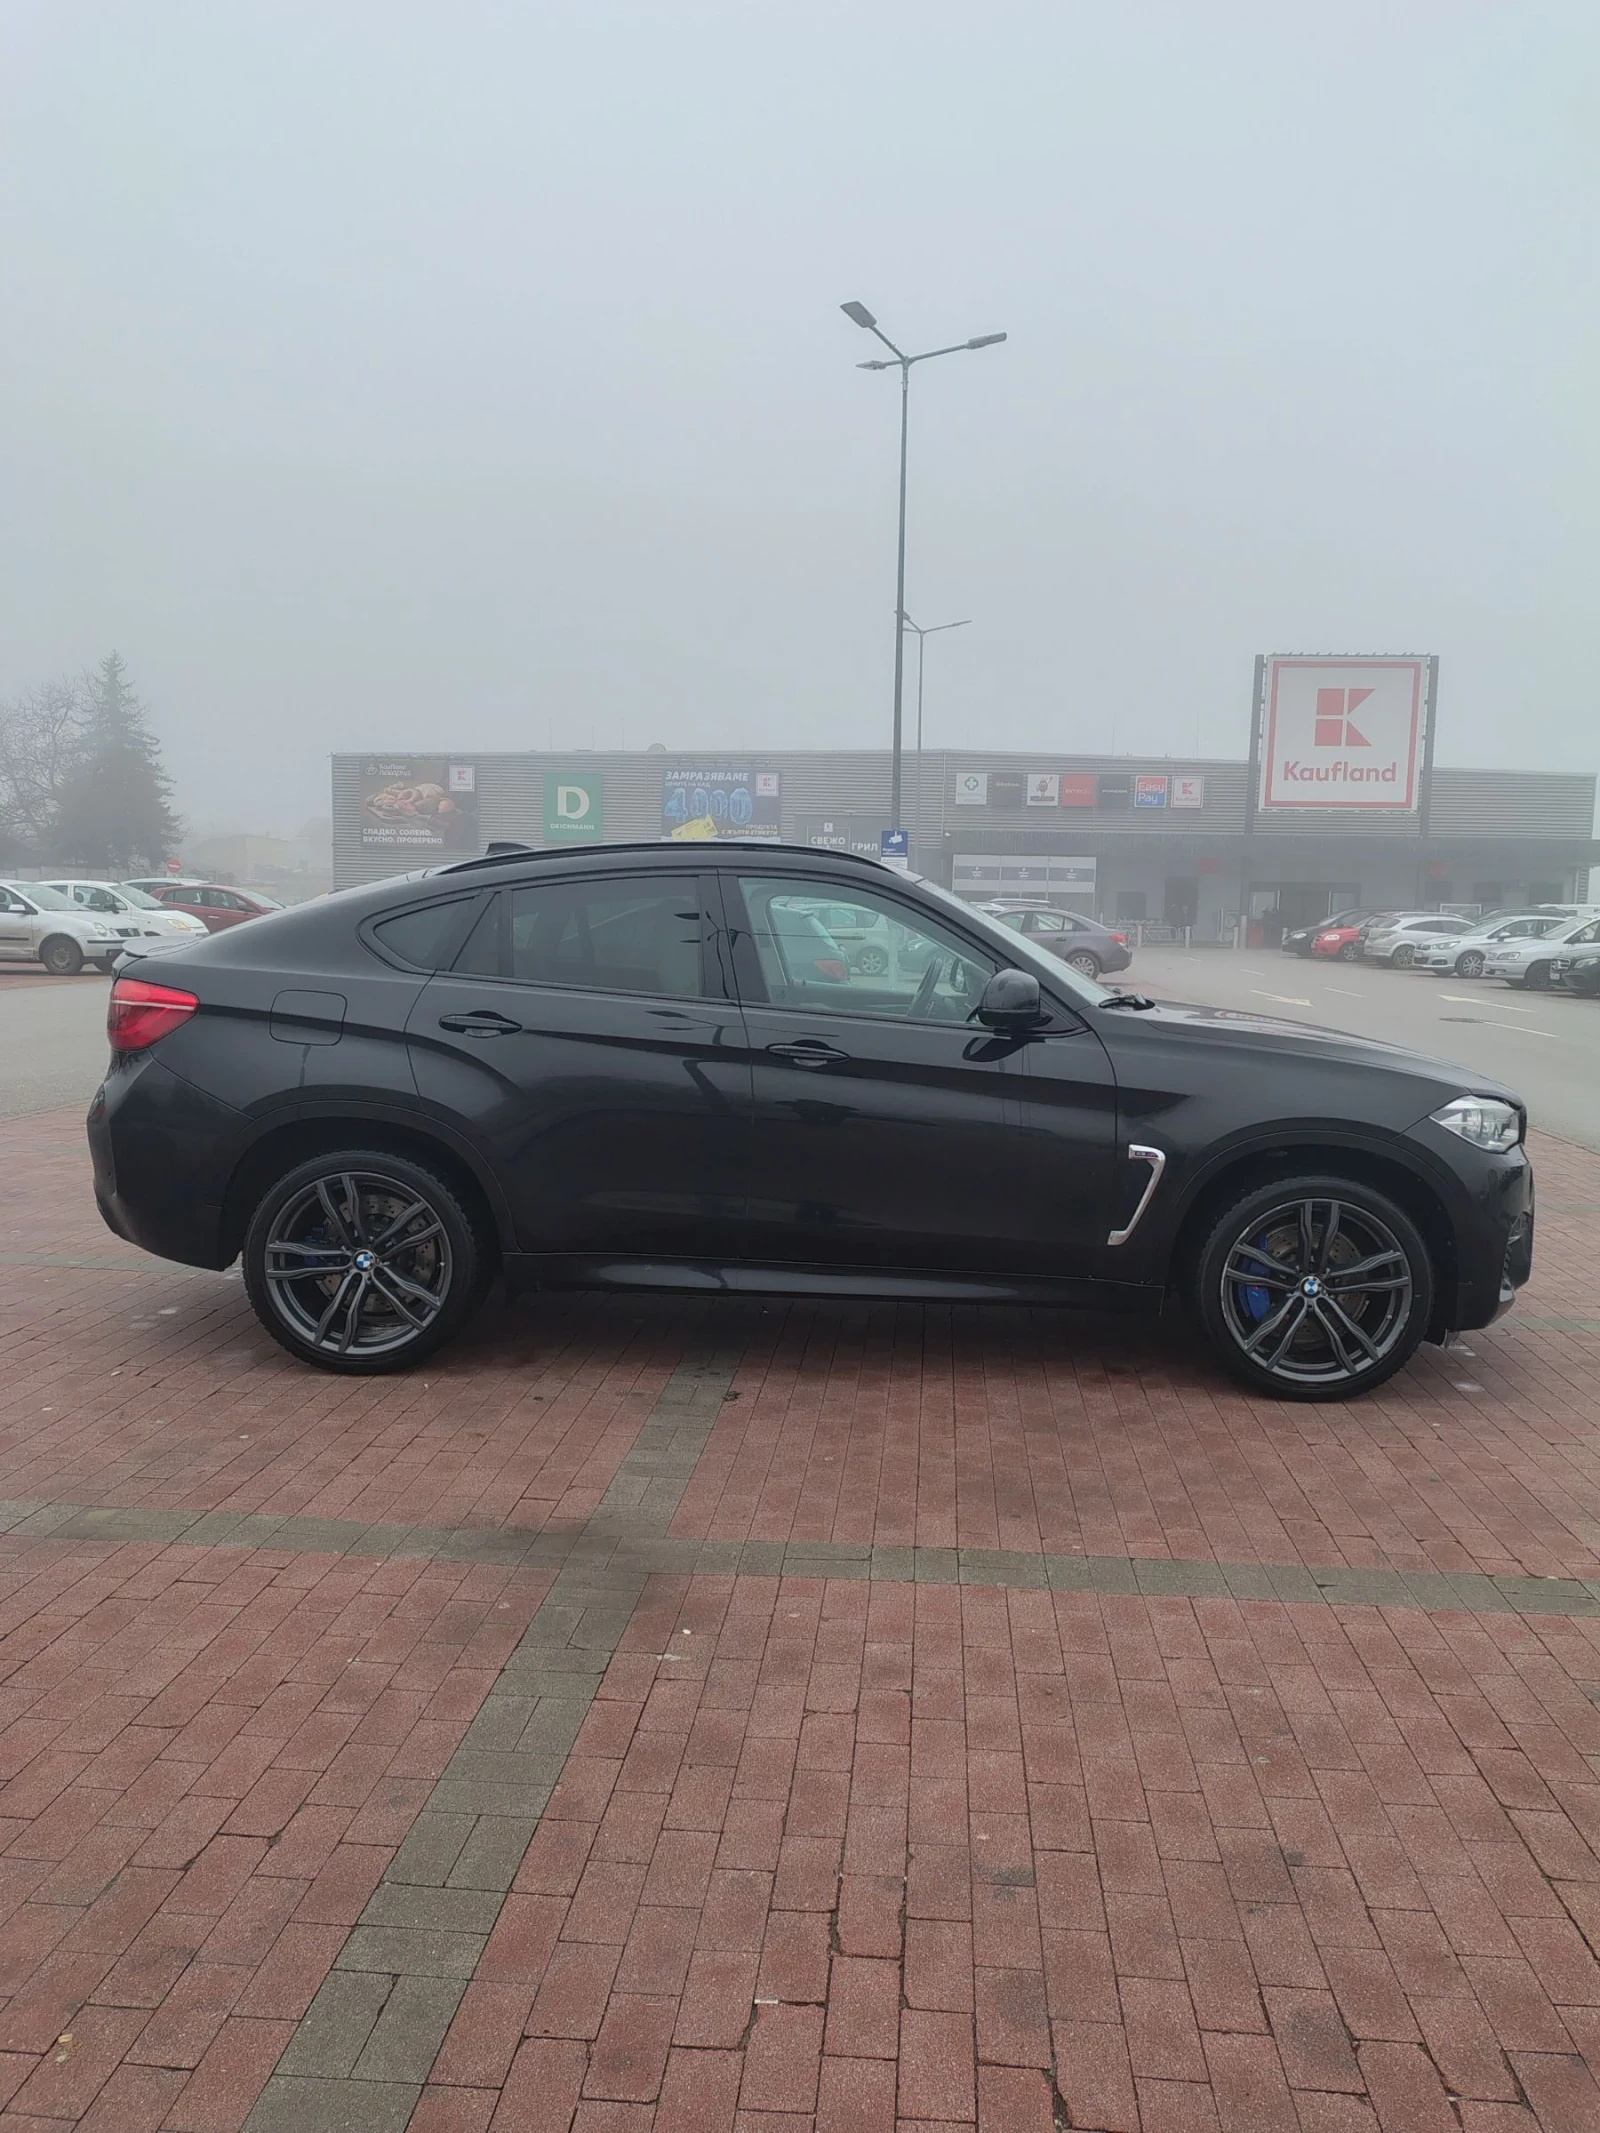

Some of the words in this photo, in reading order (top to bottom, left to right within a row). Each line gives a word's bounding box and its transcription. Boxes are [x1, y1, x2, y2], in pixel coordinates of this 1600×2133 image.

[665, 771, 750, 782] ЗАМРАЗЯВАМЕ
[1283, 761, 1397, 782] Kaufland
[1138, 782, 1164, 794] Easy
[1137, 793, 1158, 804] Pay
[363, 828, 397, 836] СЛАДКО.
[811, 836, 846, 845] СВЕЖО
[851, 843, 878, 851] ГРИЛ
